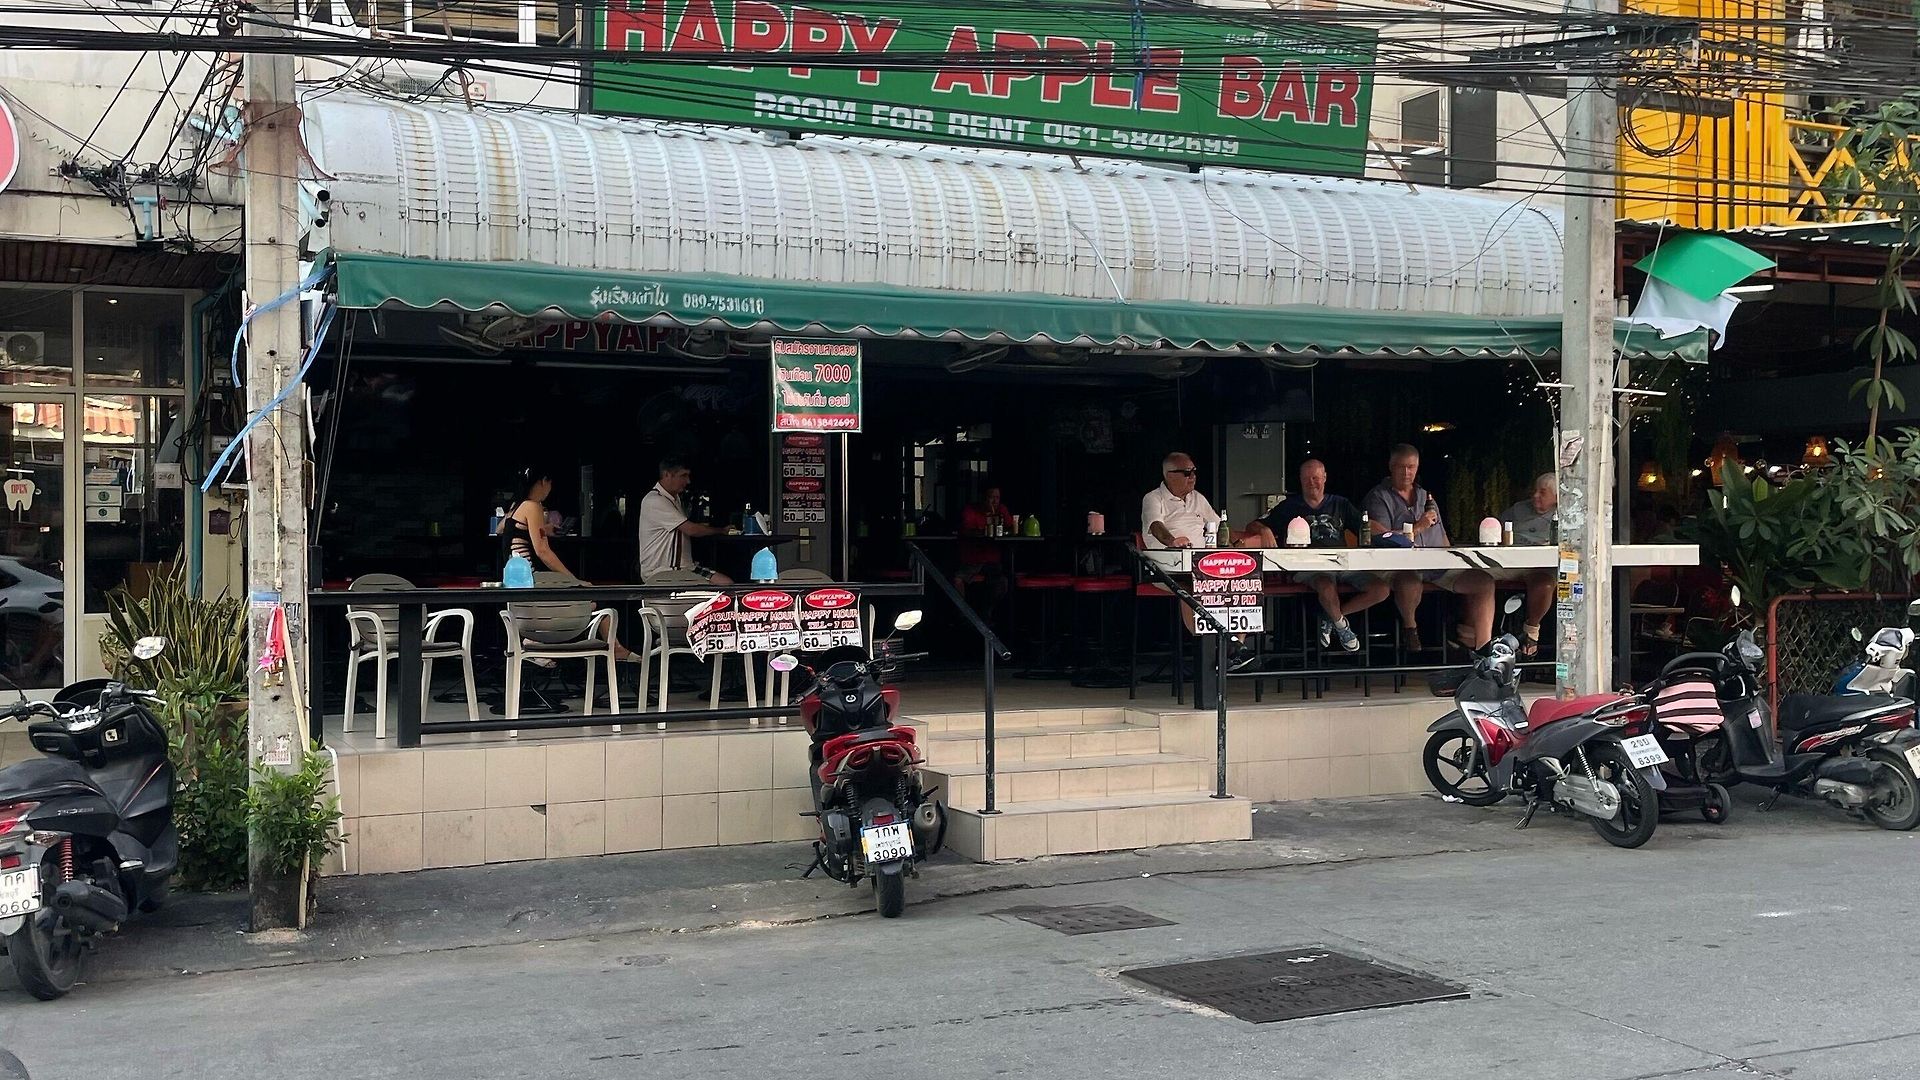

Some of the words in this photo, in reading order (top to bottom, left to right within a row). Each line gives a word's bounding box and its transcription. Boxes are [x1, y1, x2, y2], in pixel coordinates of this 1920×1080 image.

[603, 0, 902, 86] HAPPY
[931, 25, 1184, 113] APPLE
[1217, 56, 1361, 127] BAR
[754, 92, 856, 126] ROOM
[872, 104, 934, 132] FOR
[947, 112, 1031, 142] RENT
[814, 364, 851, 383] 7000
[784, 467, 796, 476] 60
[805, 467, 816, 476] 50
[11, 483, 28, 494] OPEN
[784, 512, 796, 521] 60
[805, 512, 817, 521] 50
[1203, 558, 1252, 566] HAPPYAPPLE
[1193, 580, 1229, 592] HAPPY
[1231, 580, 1262, 592] HOUR
[1241, 595, 1256, 605] PM
[738, 612, 769, 621] HAPPY
[801, 610, 831, 620] HAPPY
[832, 609, 858, 618] HOUR
[1231, 616, 1248, 630] 50
[708, 639, 723, 650] 50
[741, 640, 756, 651] 60
[771, 637, 787, 648] 50
[804, 637, 819, 648] 60
[832, 635, 848, 646] 50
[873, 846, 907, 861] 3090
